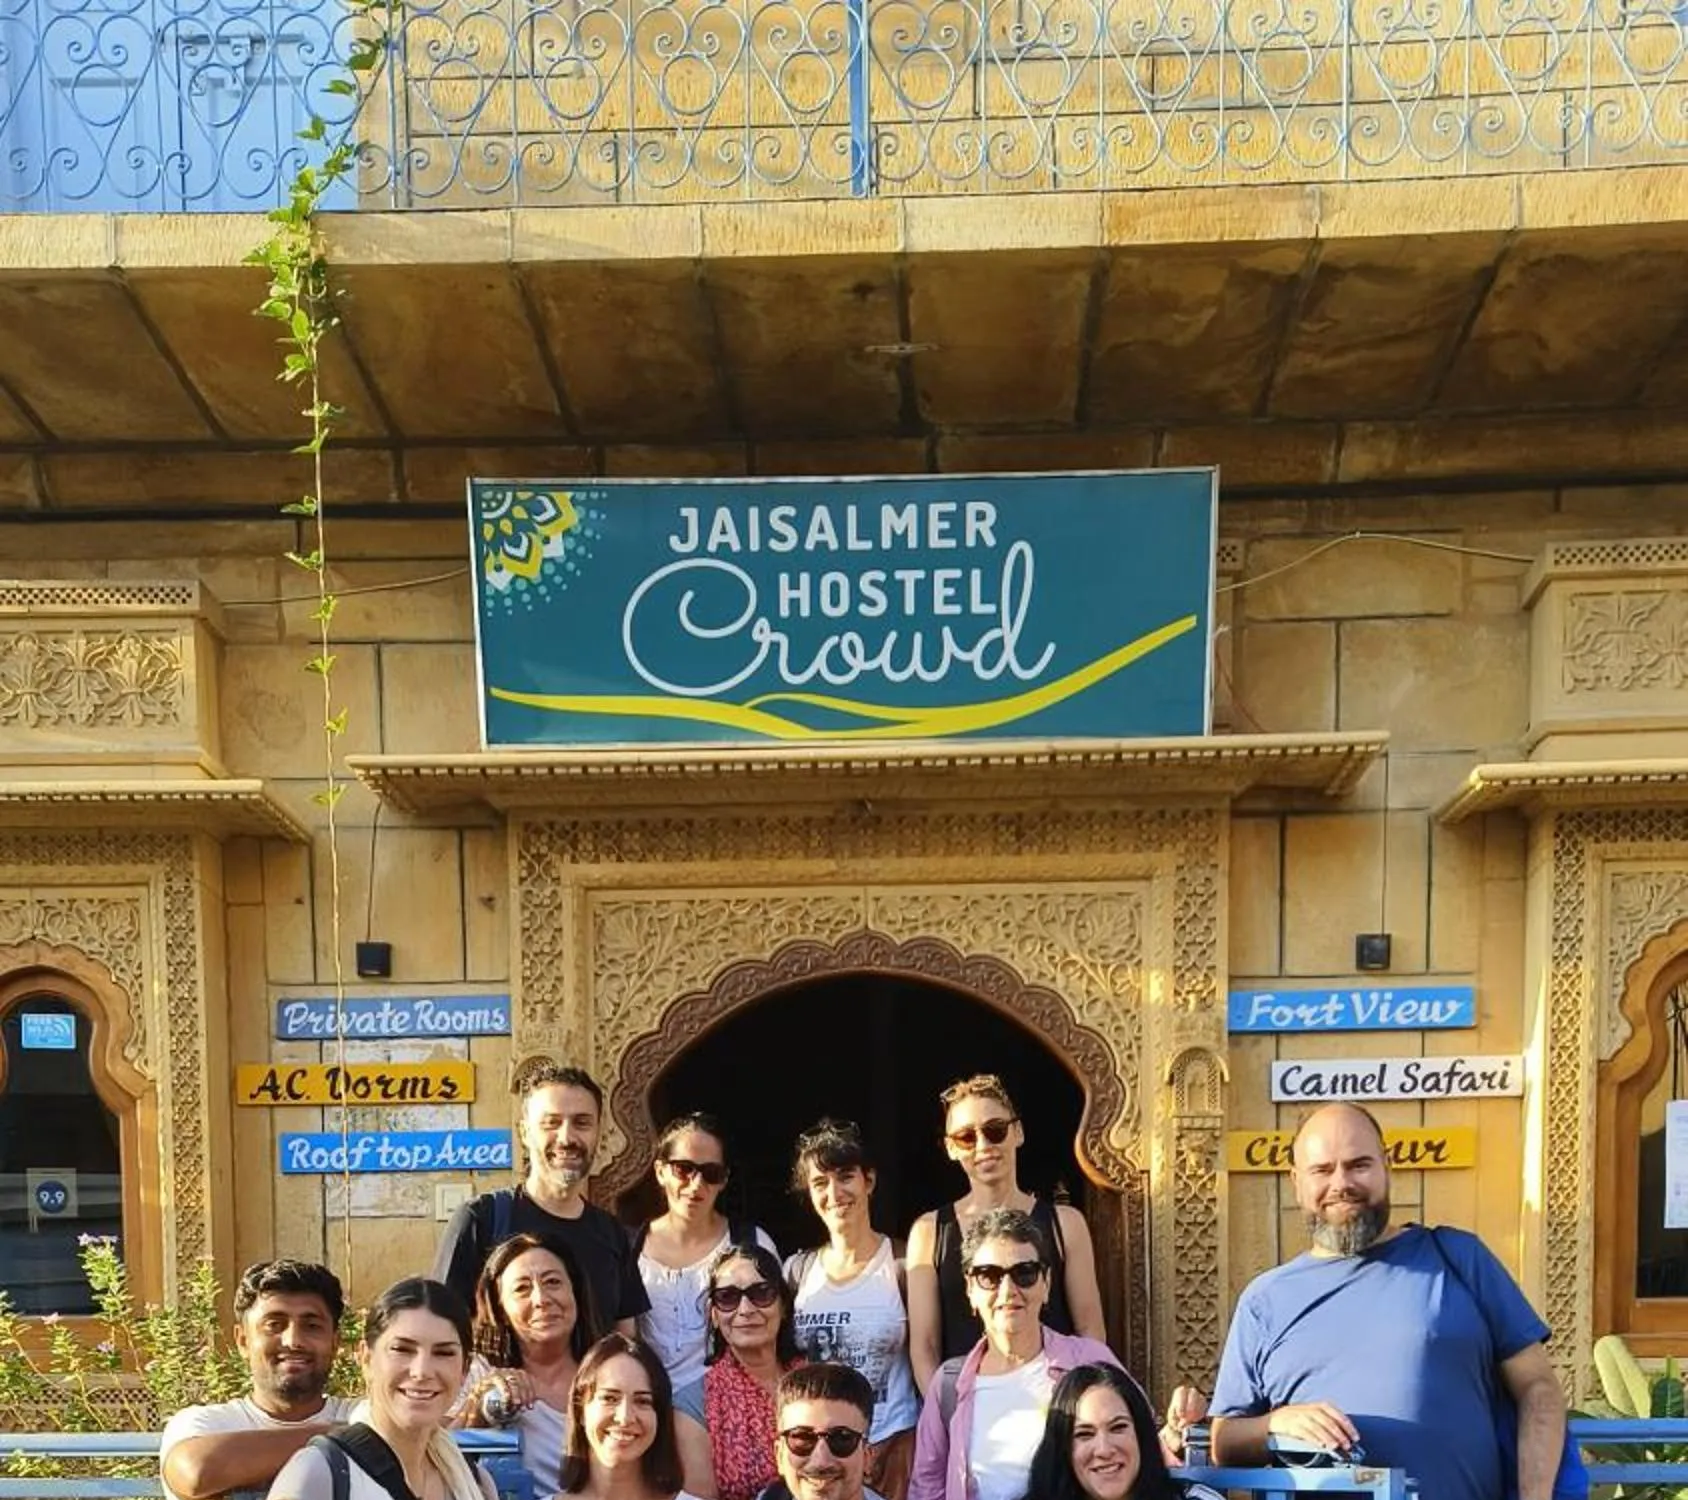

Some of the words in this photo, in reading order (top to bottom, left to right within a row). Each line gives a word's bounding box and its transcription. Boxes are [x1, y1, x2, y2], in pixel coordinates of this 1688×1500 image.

[669, 501, 997, 554] JAISALMER
[778, 568, 997, 618] HOSTEL
[622, 540, 1056, 697] Crowd
[283, 999, 411, 1035] Private
[411, 1000, 506, 1031] Rooms
[1247, 992, 1343, 1028] Fort
[1349, 991, 1463, 1026] View
[249, 1068, 311, 1101] A.C.
[325, 1066, 462, 1100] Dorms
[1279, 1063, 1387, 1097] Camel
[1400, 1058, 1511, 1096] Safari
[432, 1132, 510, 1166] Area
